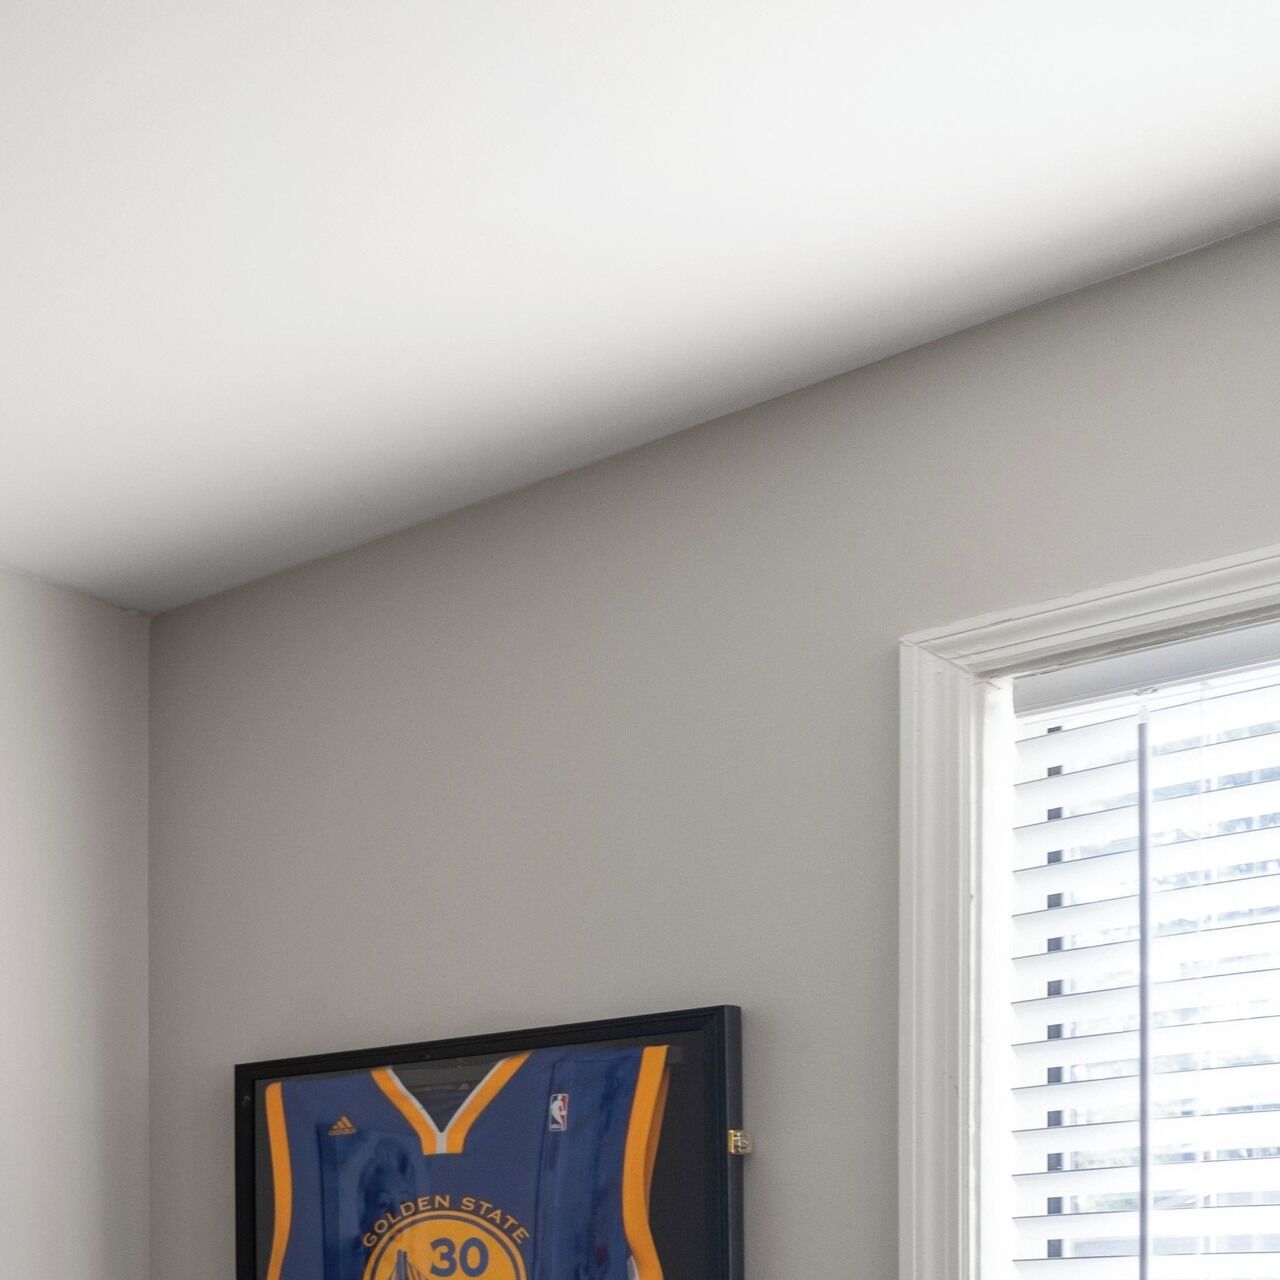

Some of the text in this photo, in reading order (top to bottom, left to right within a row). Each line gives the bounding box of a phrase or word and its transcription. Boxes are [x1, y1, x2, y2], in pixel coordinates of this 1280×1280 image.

[363, 1195, 530, 1247] GOLDEN STATE
[430, 1237, 489, 1278] 30
